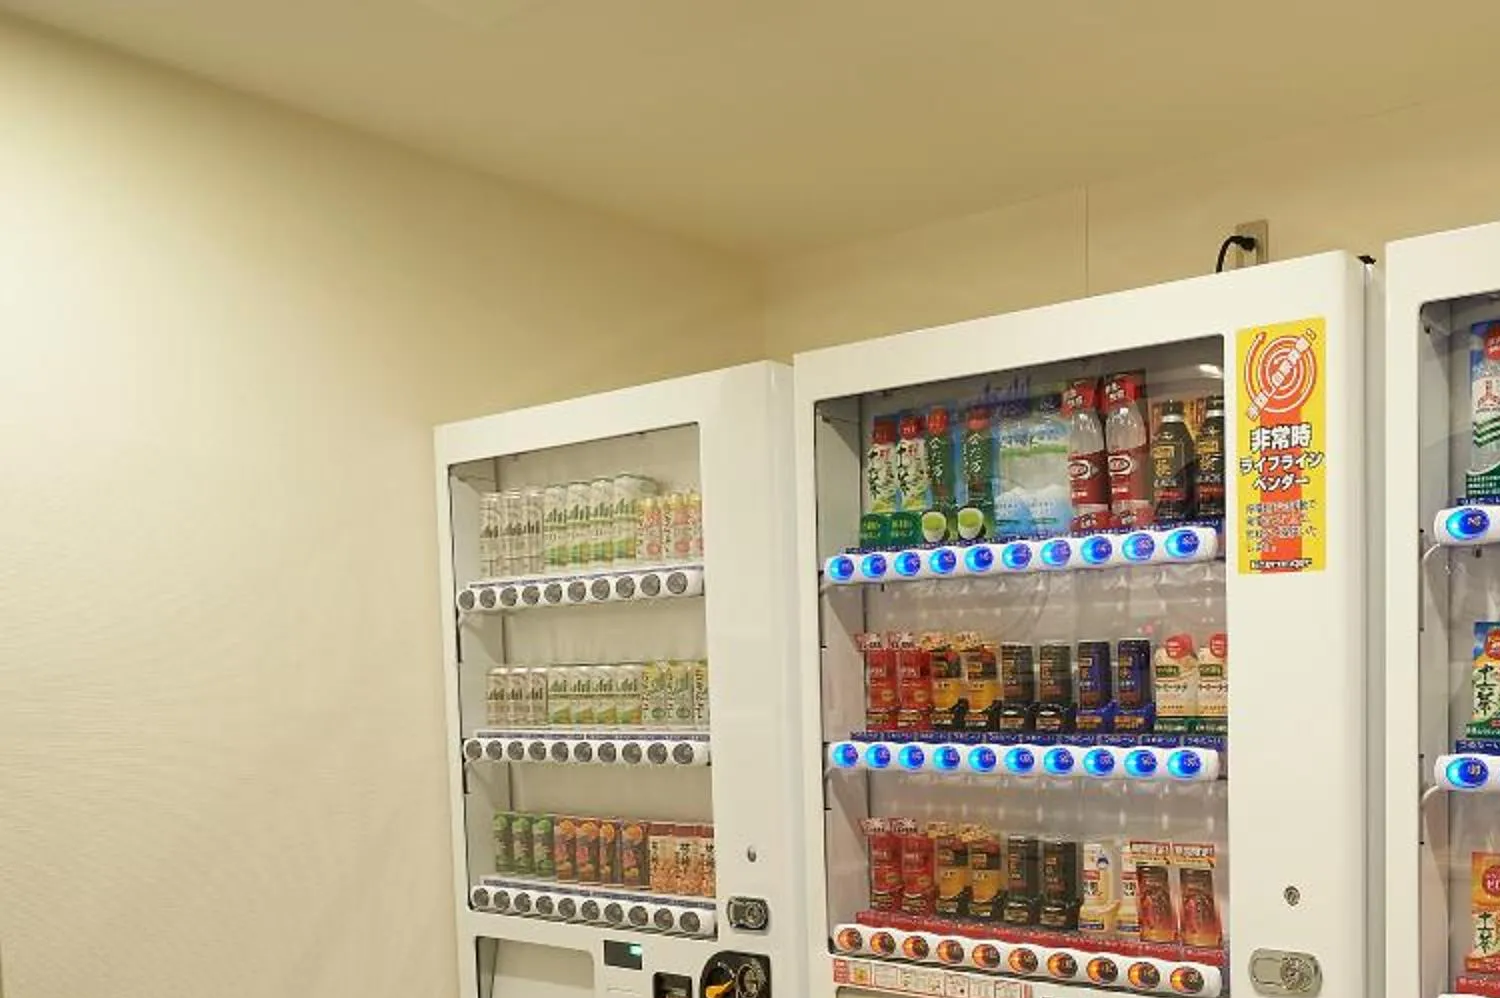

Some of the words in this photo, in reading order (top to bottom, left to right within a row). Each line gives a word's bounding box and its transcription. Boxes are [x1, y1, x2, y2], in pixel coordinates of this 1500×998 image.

[1249, 422, 1312, 451] 非常時
[1239, 450, 1325, 476] ライフライン
[1253, 471, 1310, 492] ベンダー
